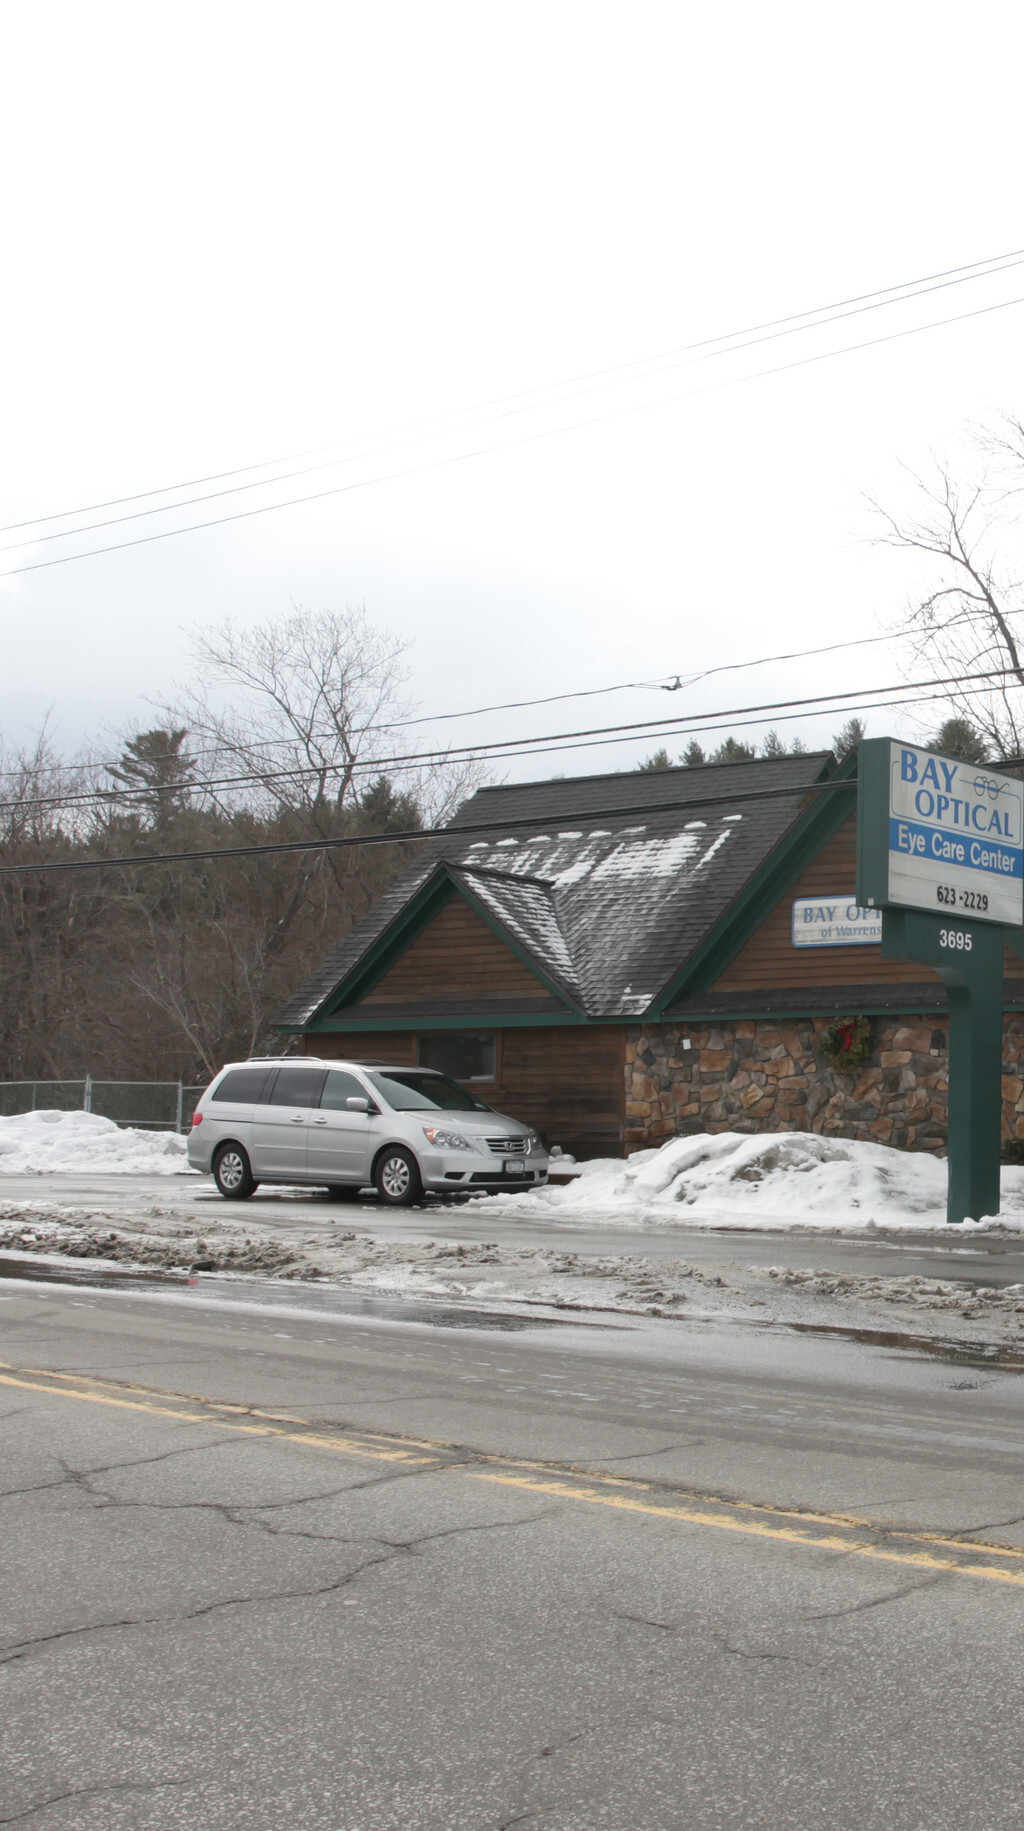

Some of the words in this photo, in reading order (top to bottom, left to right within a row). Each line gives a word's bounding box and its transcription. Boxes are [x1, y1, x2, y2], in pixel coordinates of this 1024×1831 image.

[900, 749, 959, 793] BAY
[915, 789, 1014, 838] OPTICAL
[898, 824, 926, 854] Eye
[931, 832, 965, 862] Care
[970, 841, 1016, 872] Center
[803, 905, 837, 923] BAY
[821, 925, 832, 938] of
[939, 929, 973, 951] 3695
